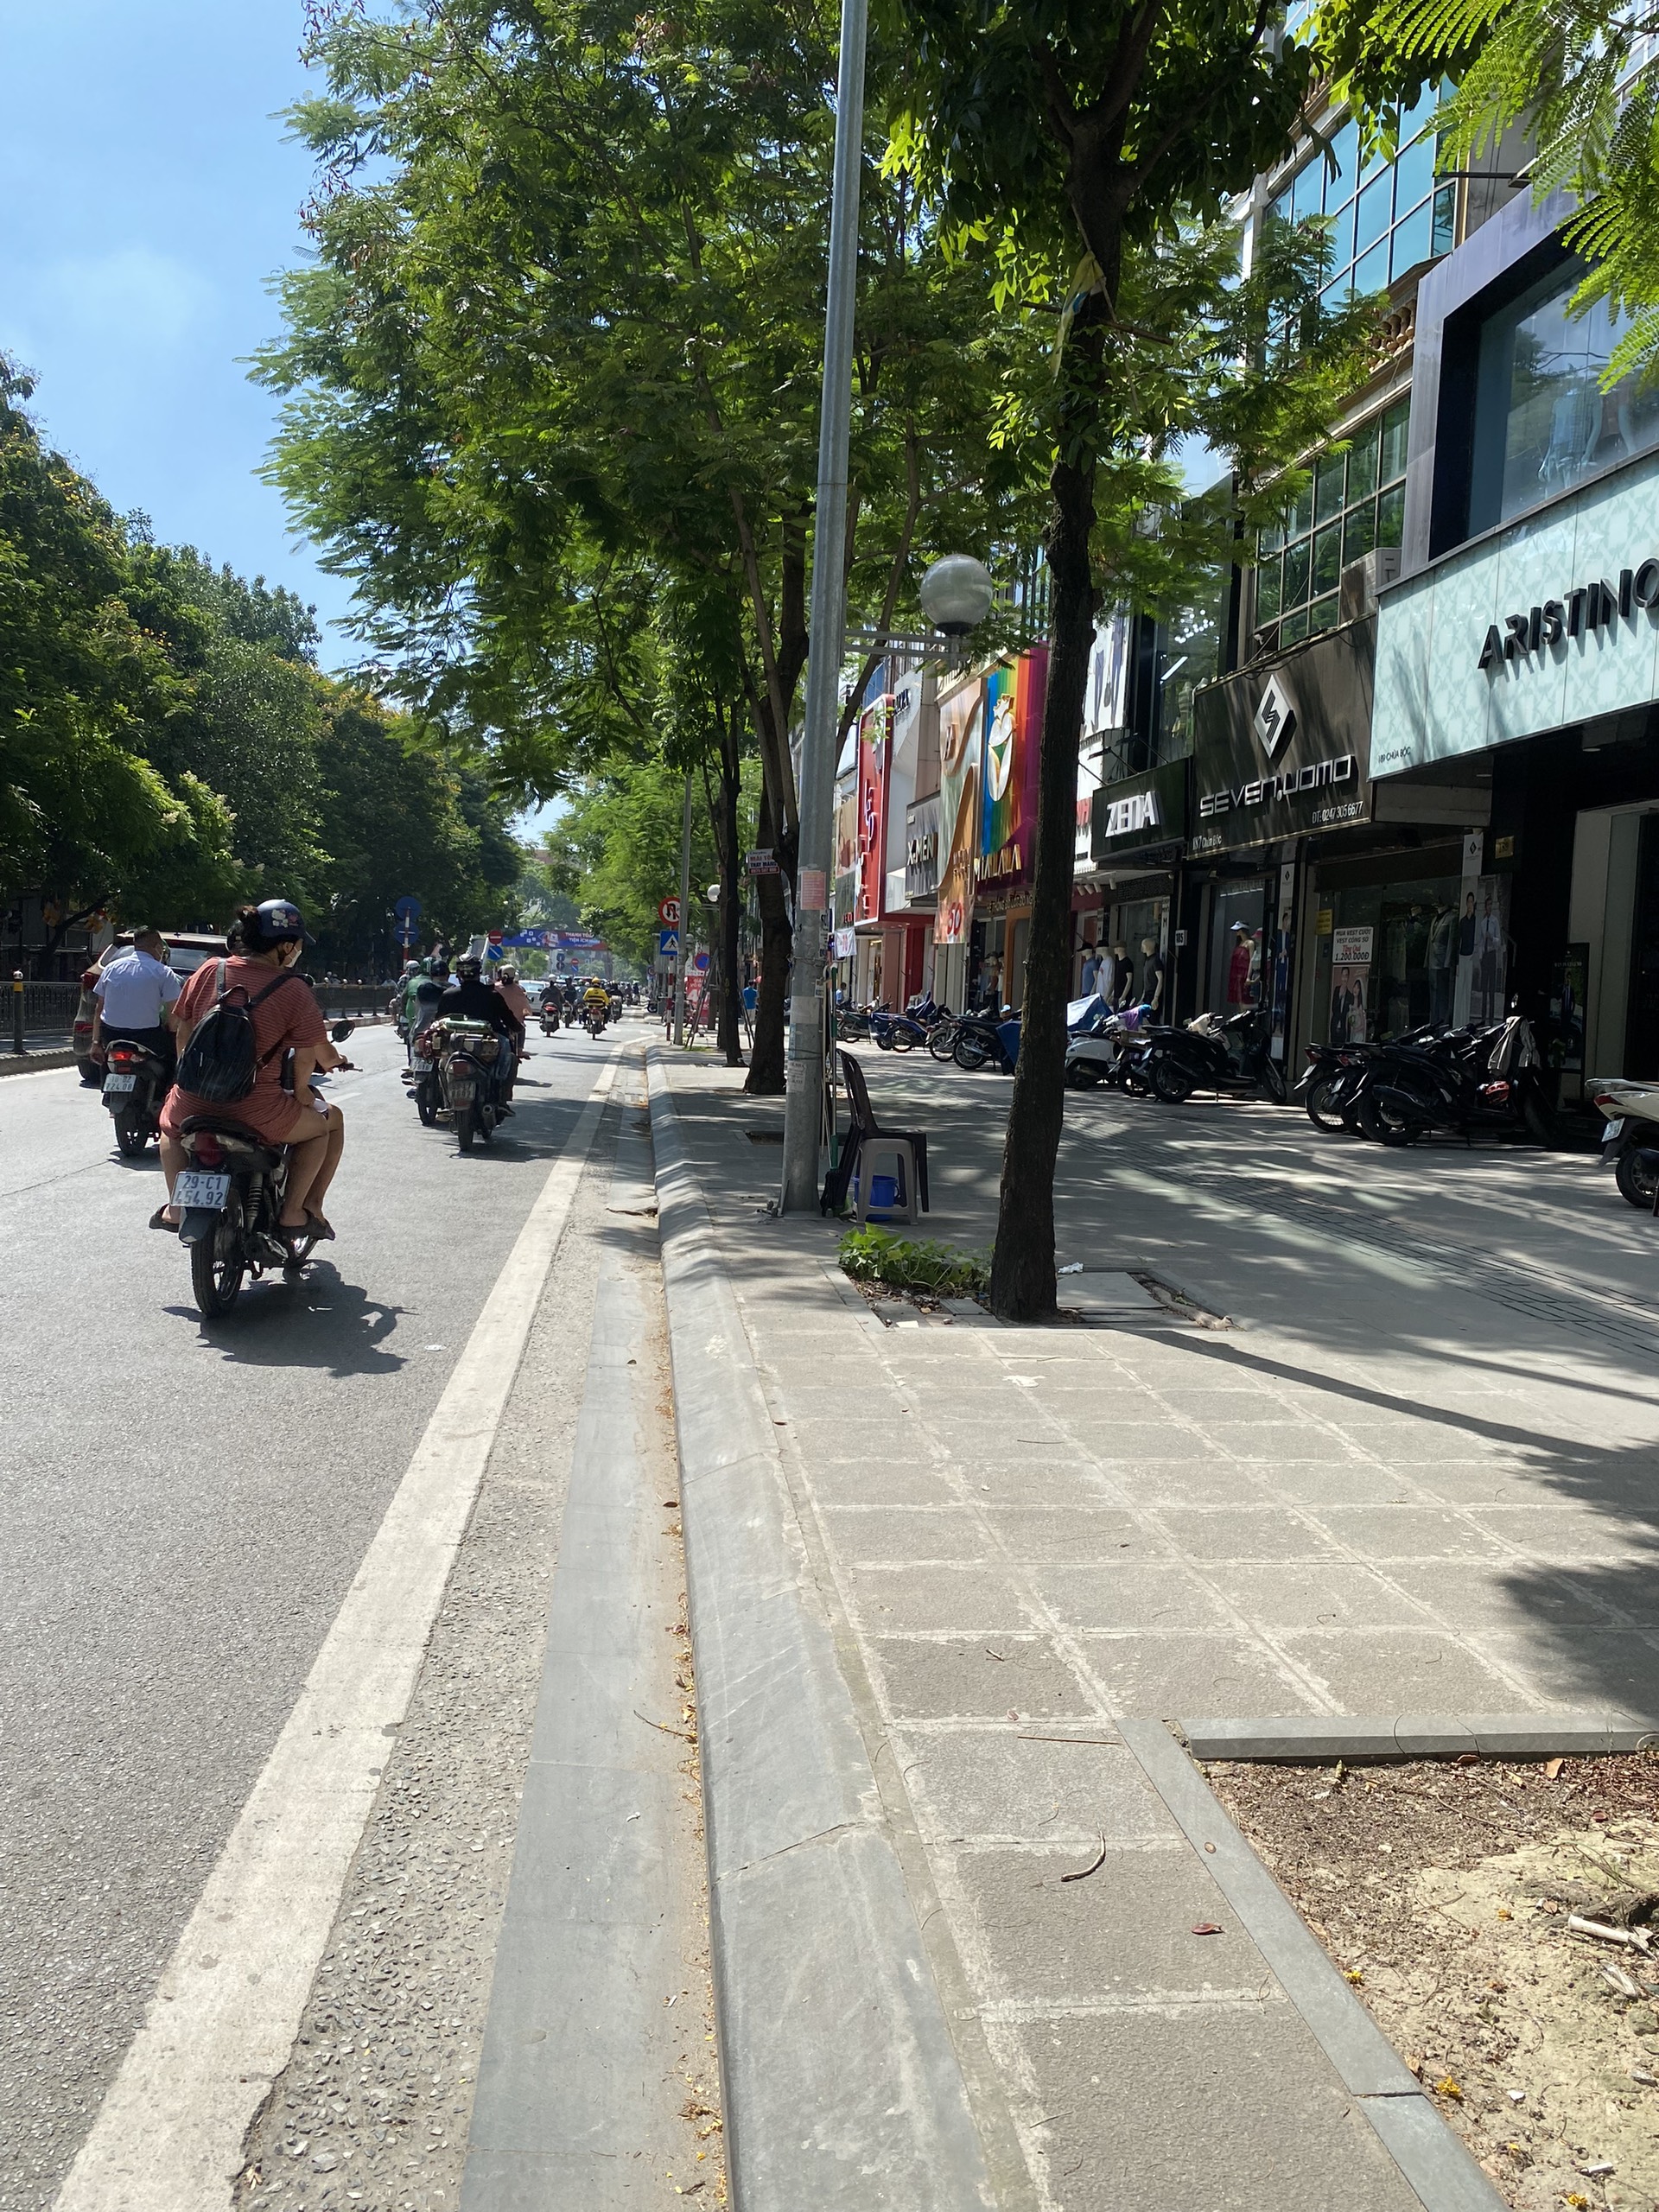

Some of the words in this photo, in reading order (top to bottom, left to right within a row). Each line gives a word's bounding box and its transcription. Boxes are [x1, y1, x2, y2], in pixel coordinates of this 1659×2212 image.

[1478, 558, 1659, 669] ARISTINO
[1348, 800, 1363, 817] 6677
[182, 1174, 222, 1190] 29-C1
